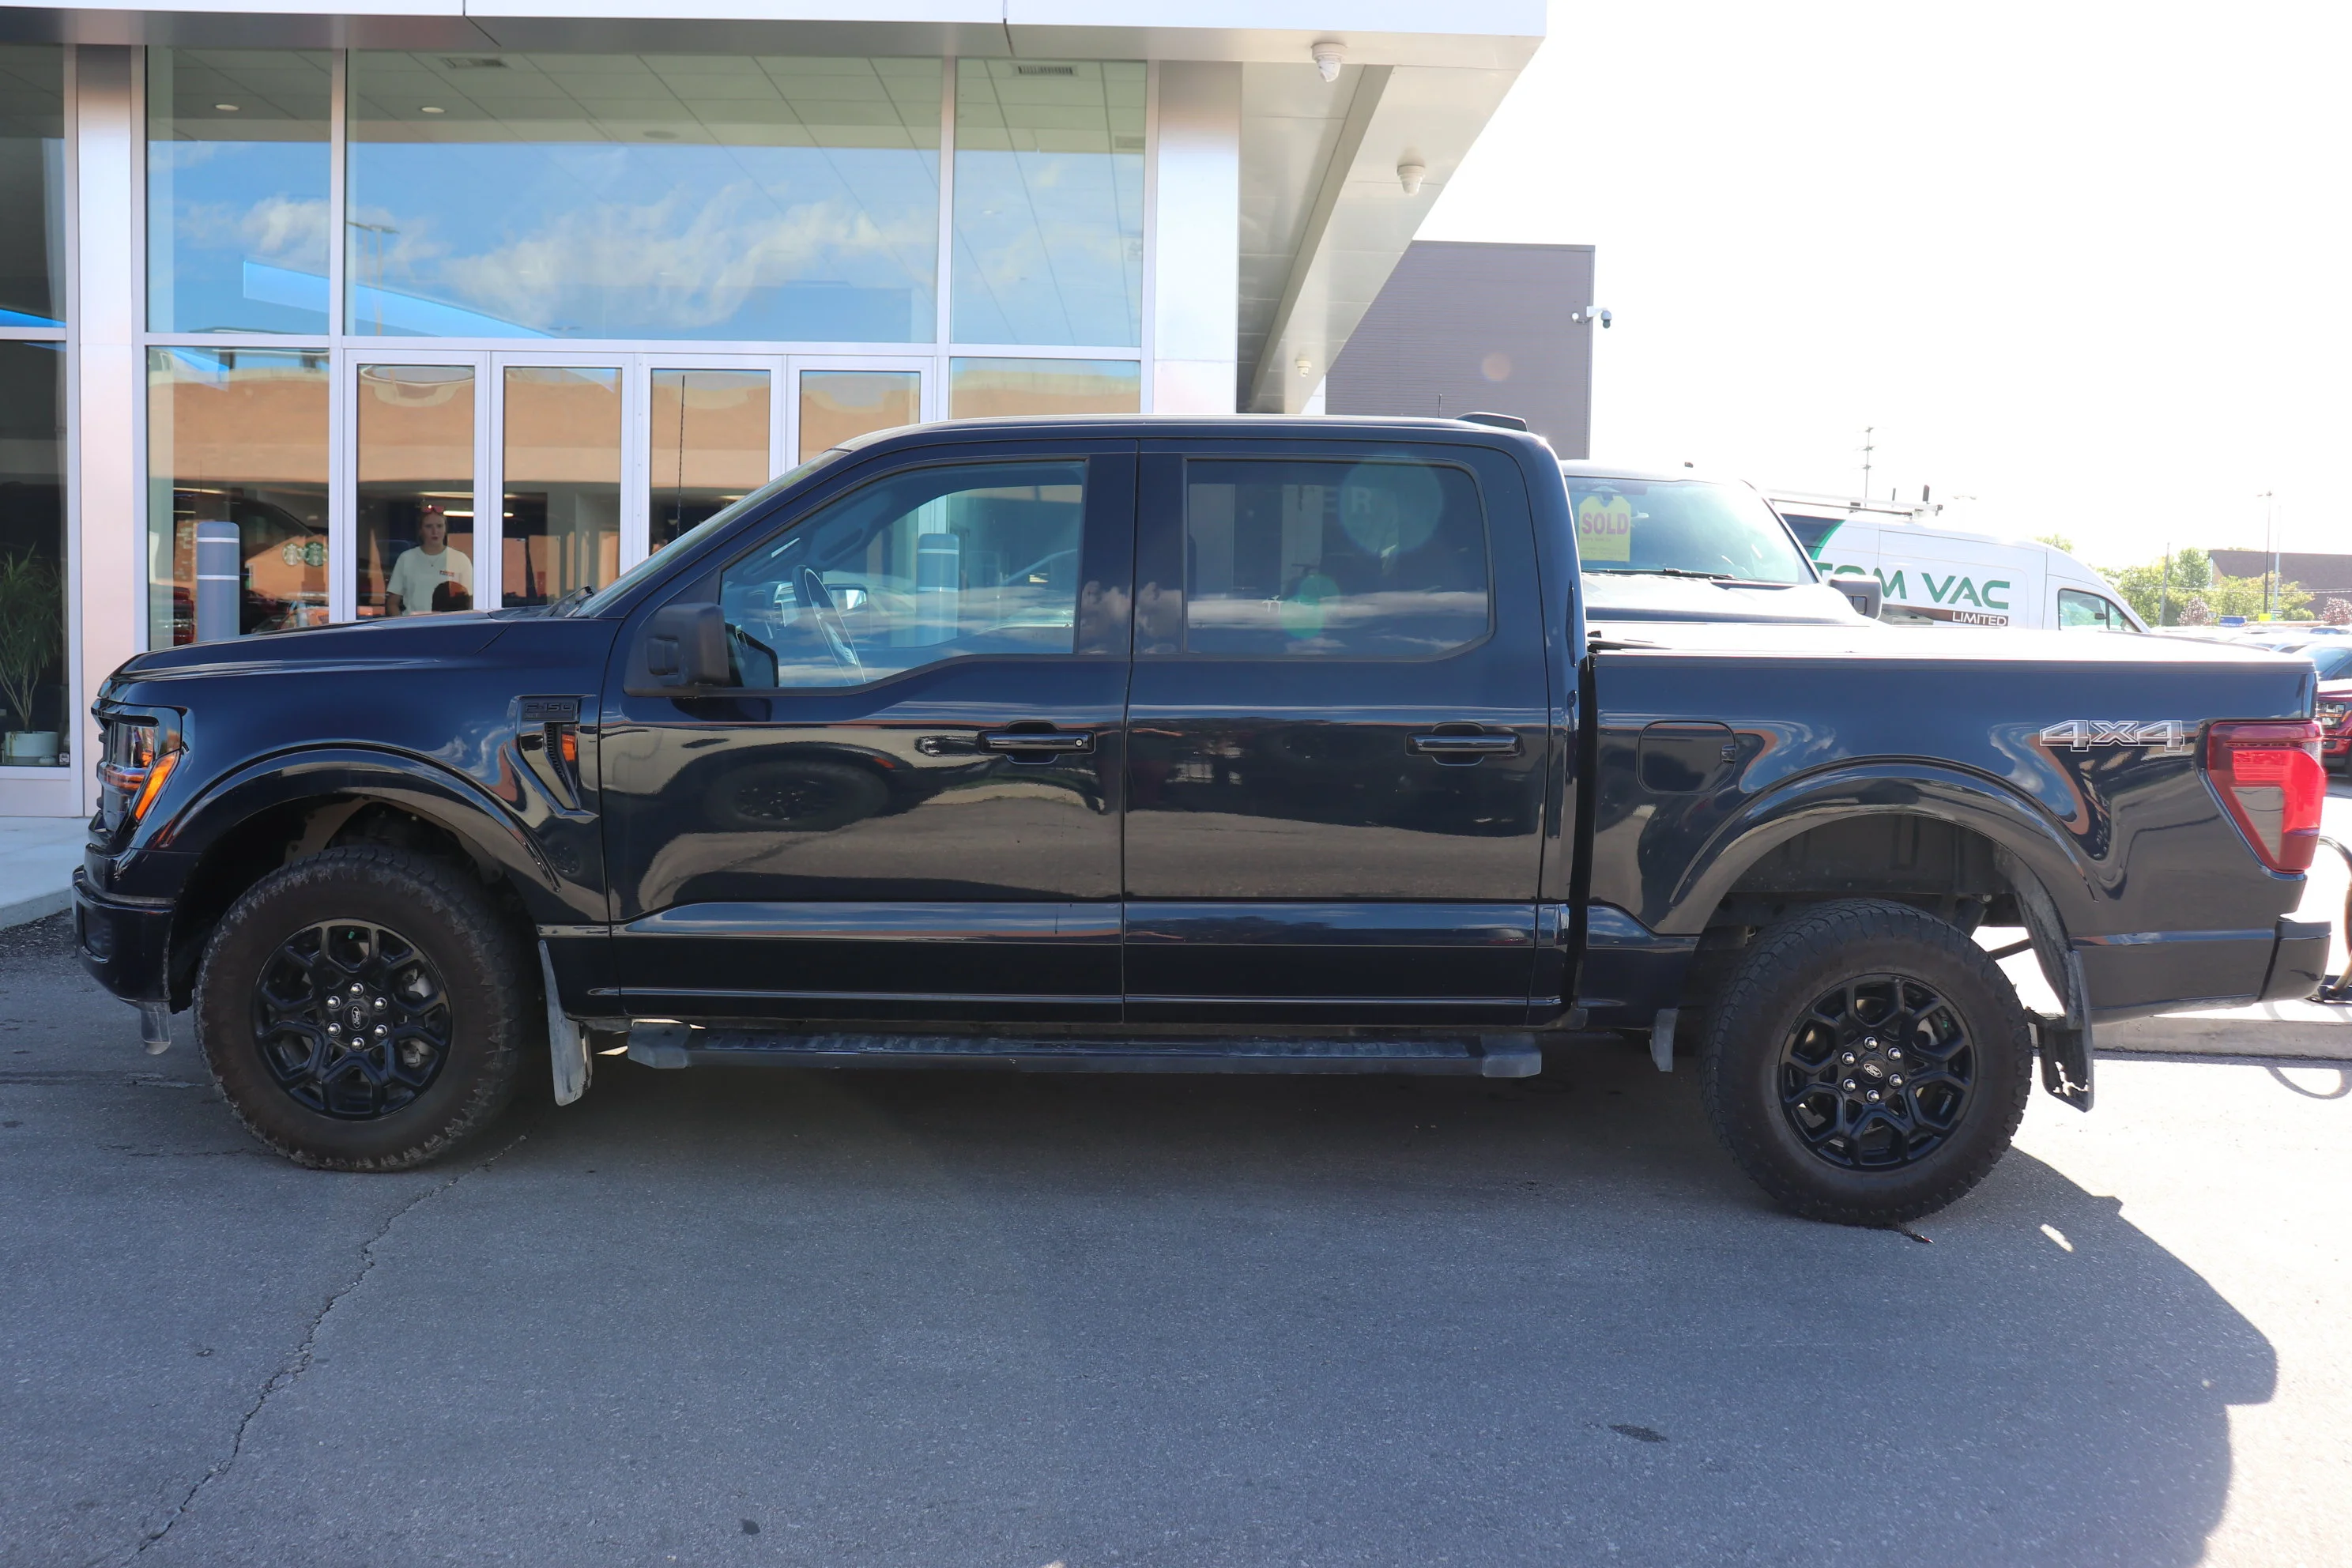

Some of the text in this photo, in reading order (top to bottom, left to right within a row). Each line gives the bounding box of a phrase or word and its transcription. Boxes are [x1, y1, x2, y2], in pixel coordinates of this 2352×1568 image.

[1581, 512, 1630, 534] SOLD
[1921, 572, 2010, 610] VAC
[1952, 611, 2007, 627] LIMITED
[525, 702, 575, 713] F-150
[1864, 1064, 1881, 1077] Ford
